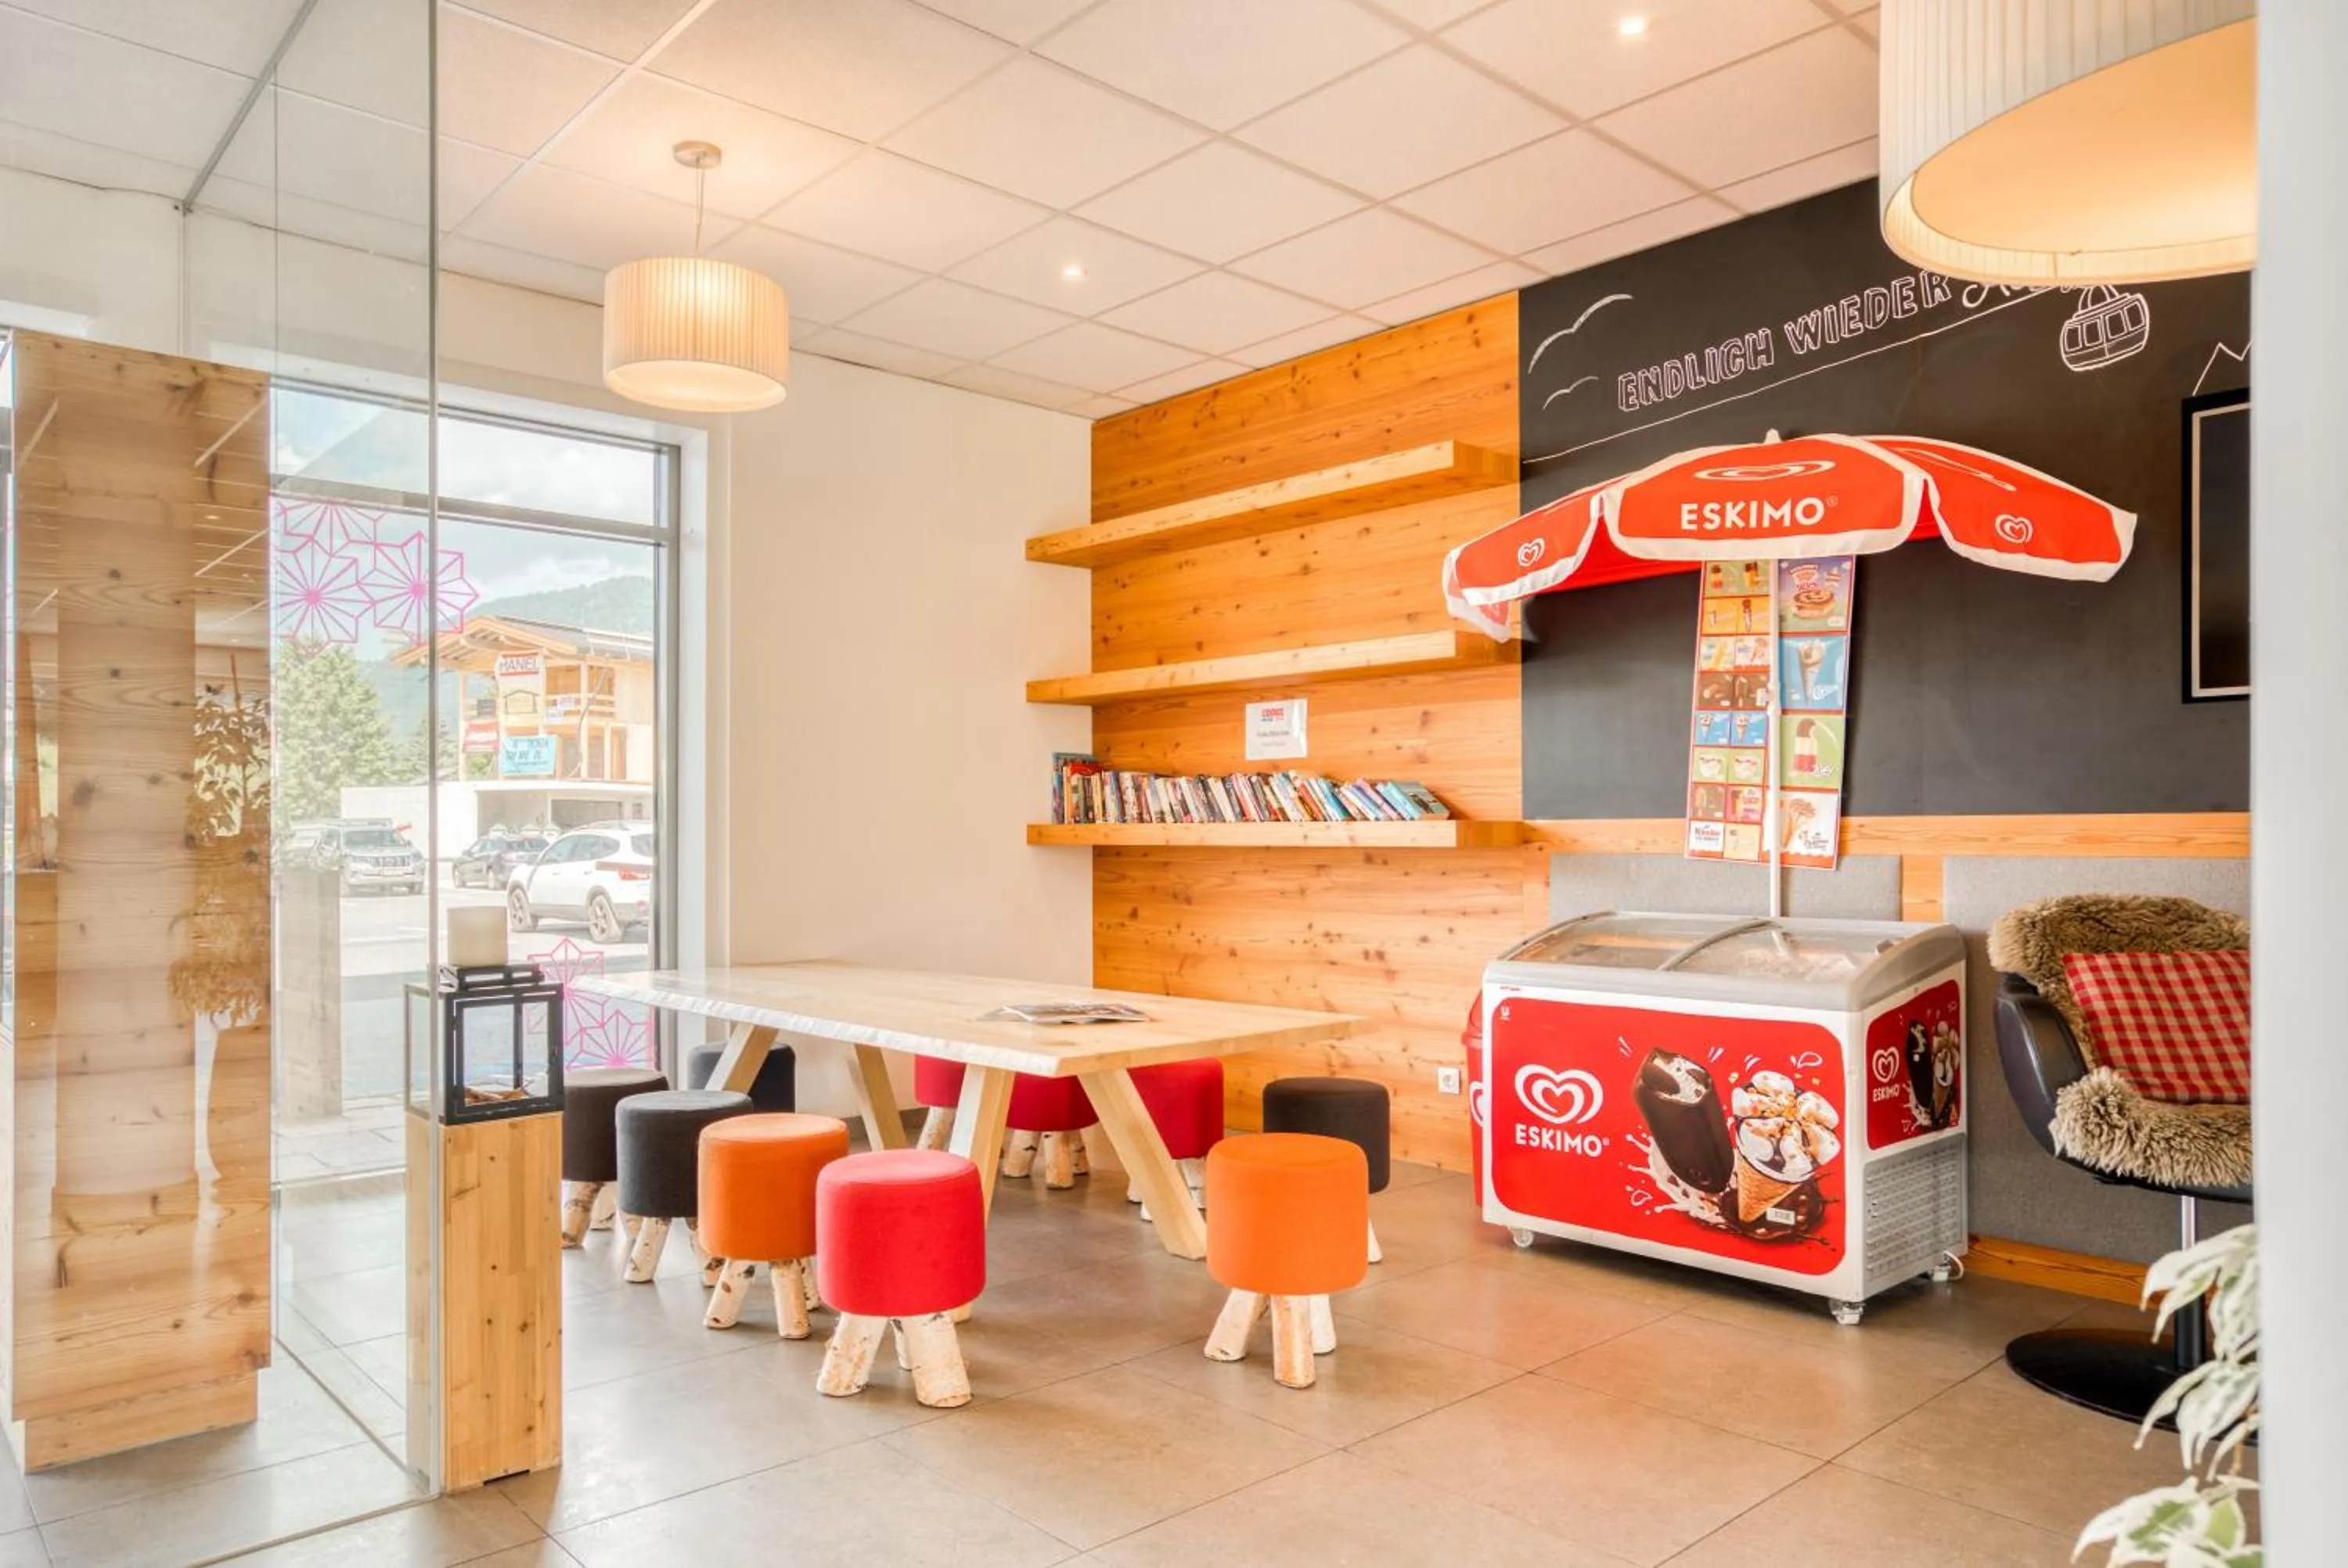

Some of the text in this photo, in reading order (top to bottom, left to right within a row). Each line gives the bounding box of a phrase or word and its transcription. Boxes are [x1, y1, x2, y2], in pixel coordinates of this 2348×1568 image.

[1617, 268, 1953, 412] ENDLICH WIEDER
[1680, 497, 1825, 530] ESKIMO
[1872, 1083, 1900, 1102] ESKIMO
[1515, 1123, 1603, 1158] ESKIMO
